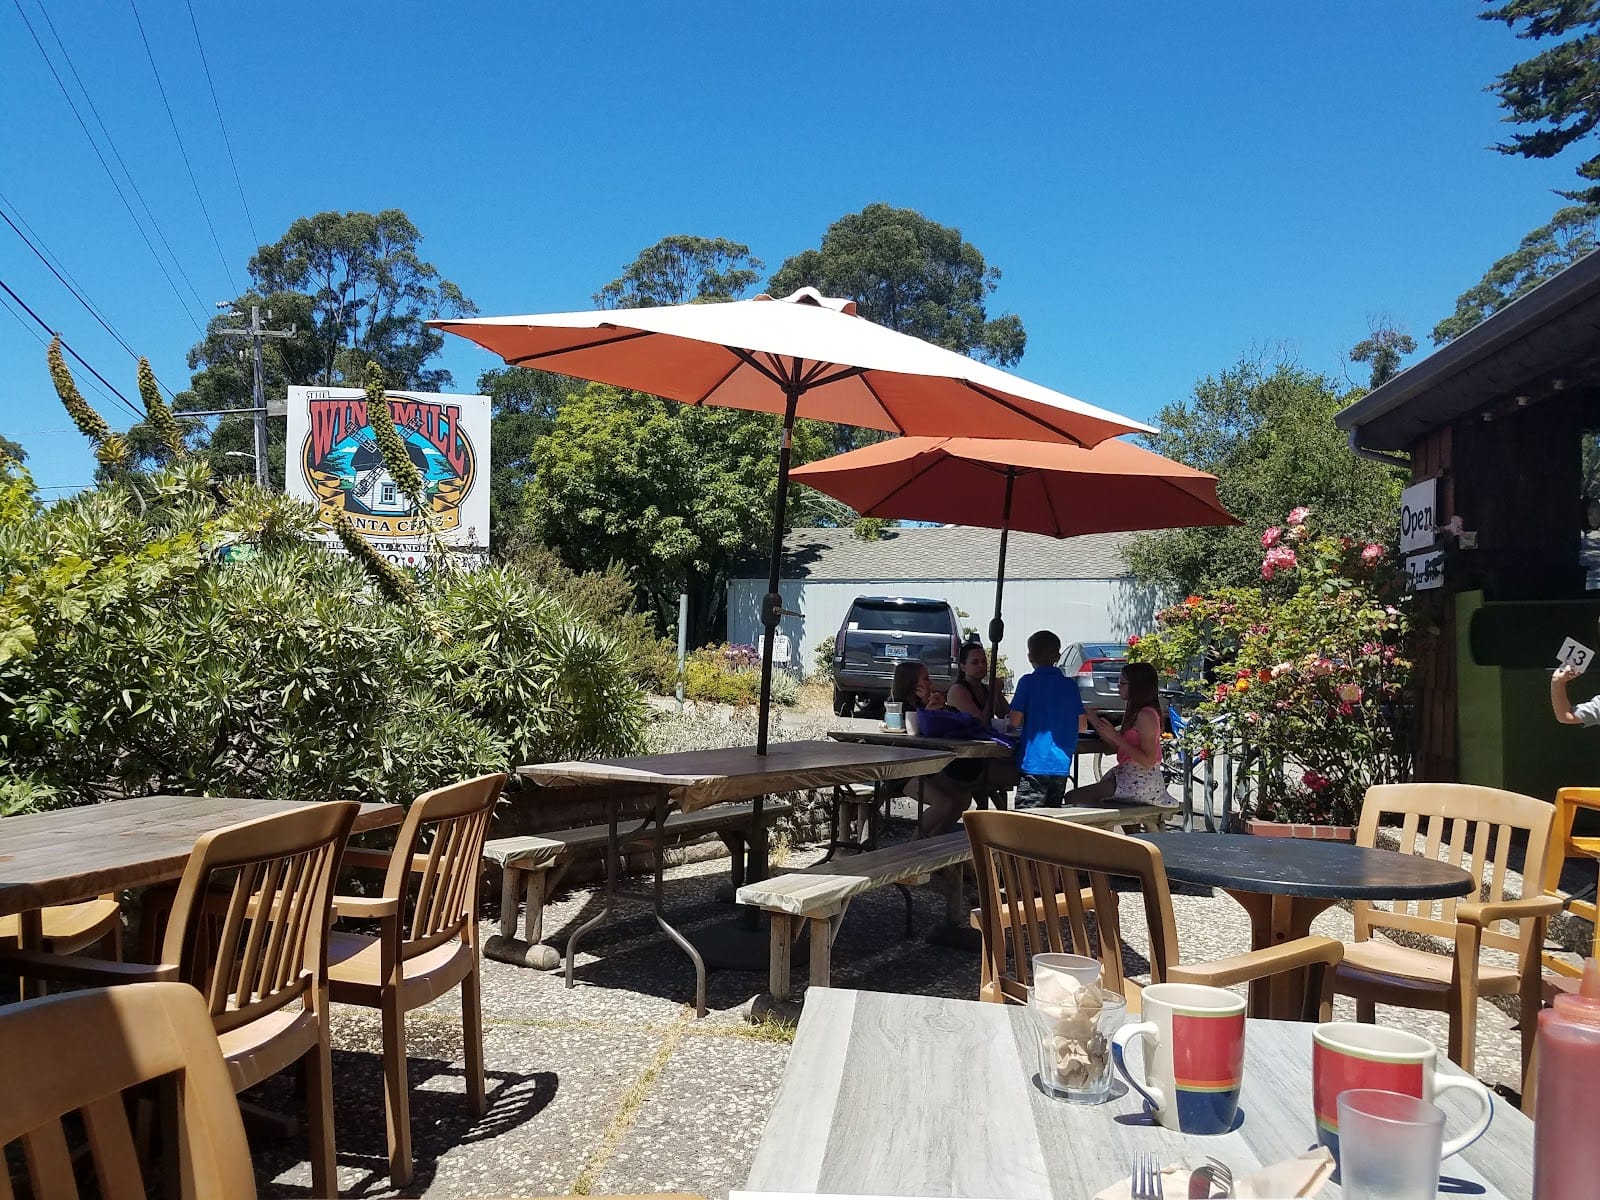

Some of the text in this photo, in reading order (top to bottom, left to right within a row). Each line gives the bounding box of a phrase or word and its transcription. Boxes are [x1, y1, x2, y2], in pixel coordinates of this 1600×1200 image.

[309, 391, 328, 399] THE
[309, 400, 466, 479] WINMILL
[340, 514, 391, 532] ANTA
[1401, 504, 1433, 540] Open
[1565, 645, 1587, 666] 13
